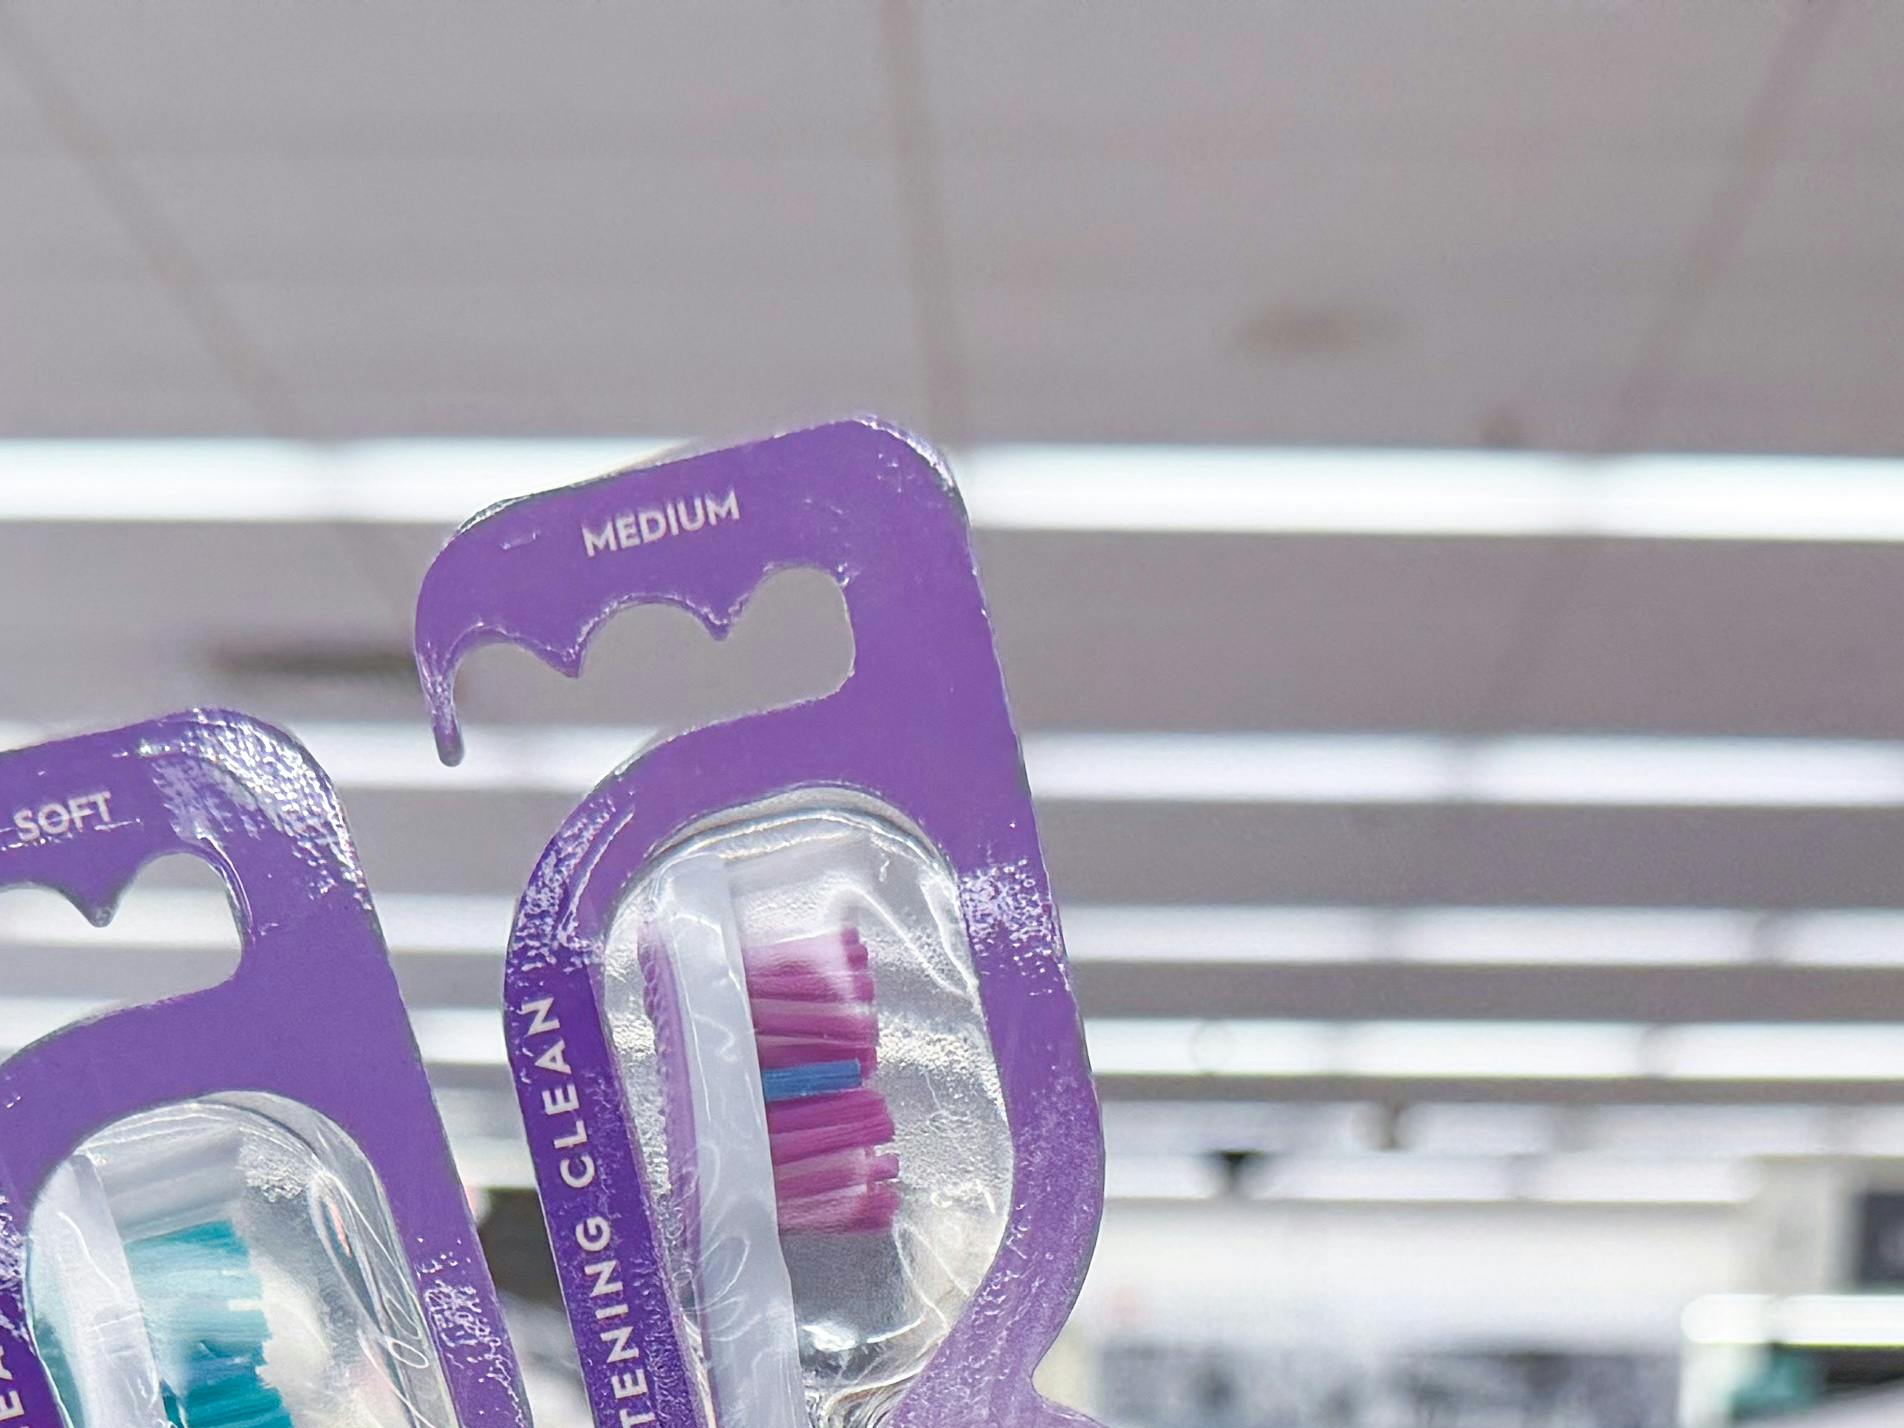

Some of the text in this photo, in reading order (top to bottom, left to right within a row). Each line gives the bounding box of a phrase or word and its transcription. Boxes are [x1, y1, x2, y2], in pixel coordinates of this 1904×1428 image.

[582, 489, 740, 557] MEDIUM
[13, 791, 112, 841] SOFT
[522, 996, 596, 1189] CLEAN
